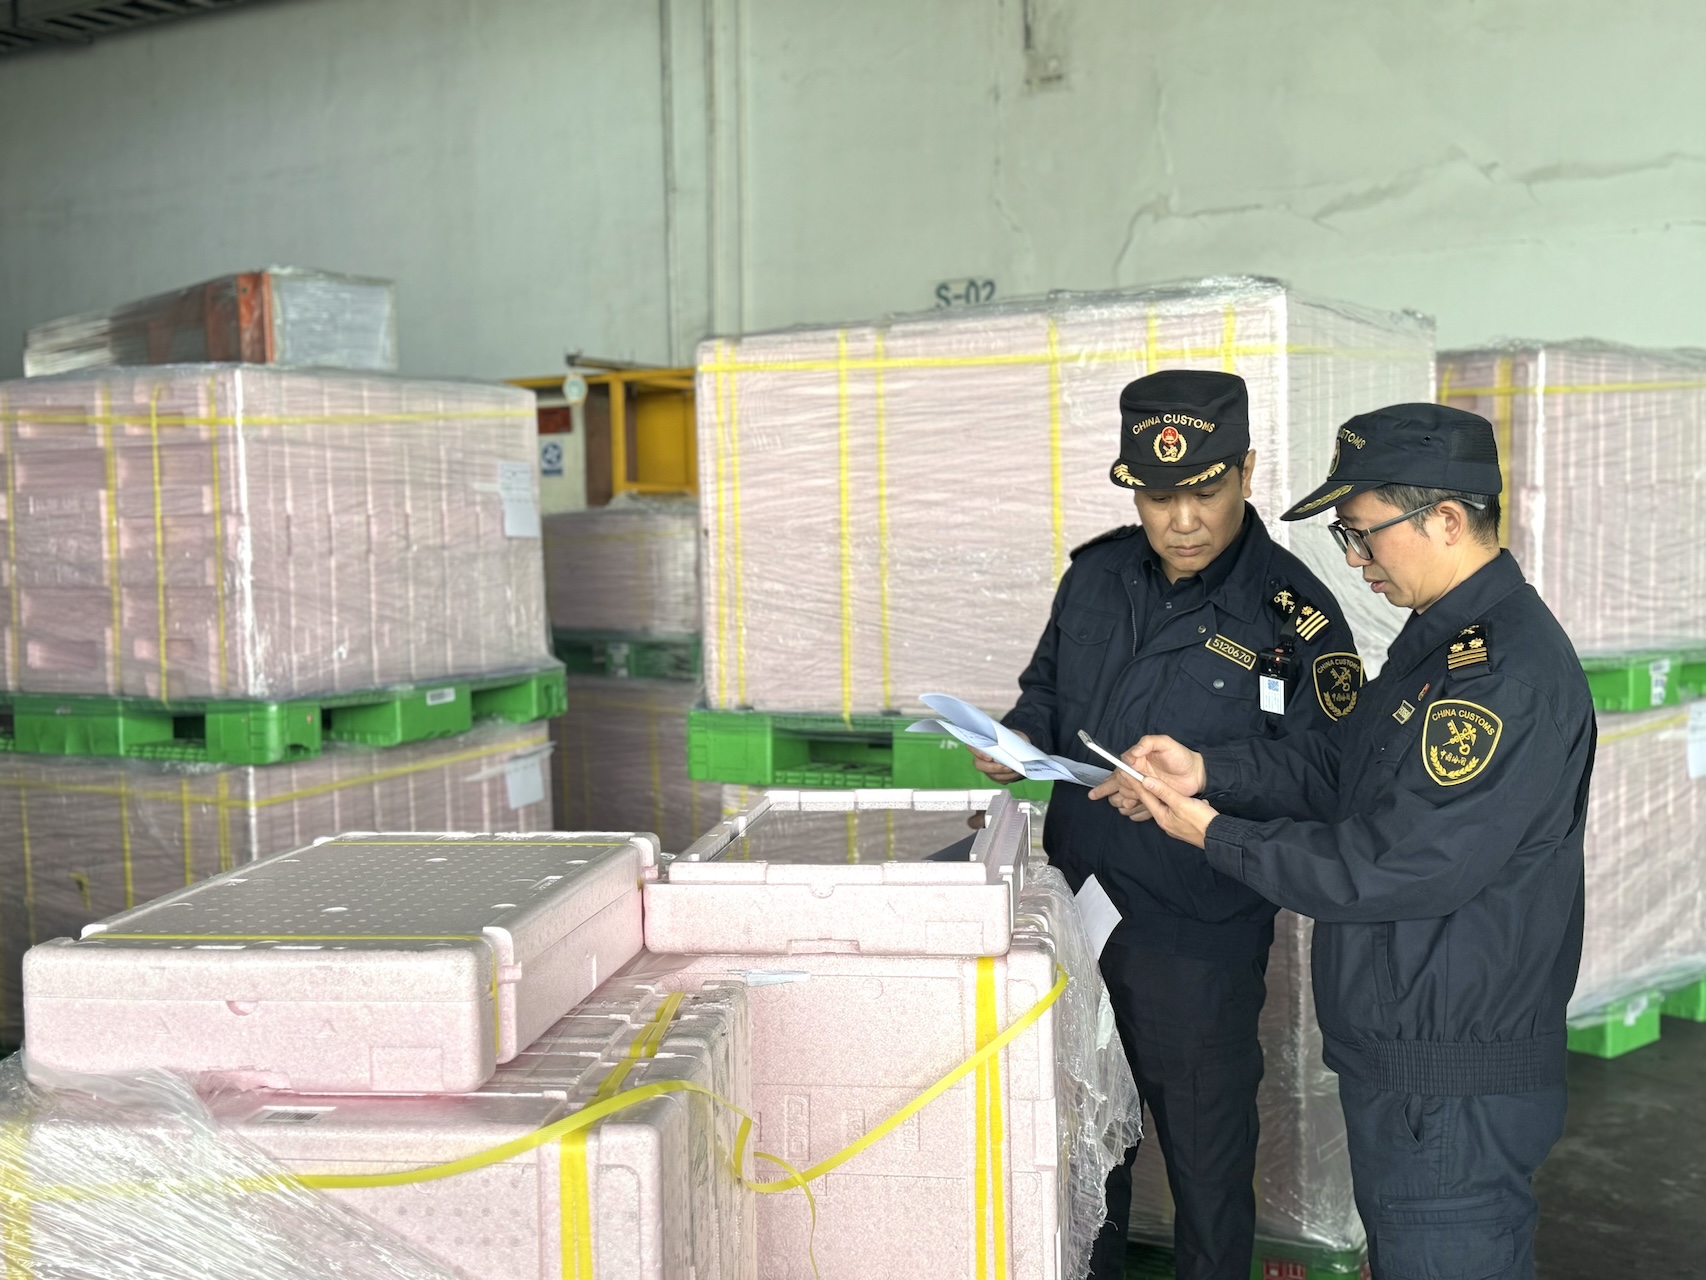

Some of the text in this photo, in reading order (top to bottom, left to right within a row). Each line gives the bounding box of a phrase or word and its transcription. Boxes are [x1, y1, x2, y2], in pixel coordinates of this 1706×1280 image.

[935, 279, 996, 307] S-02
[1132, 413, 1216, 435] CHINA CUSTOMS
[1212, 636, 1252, 664] 5120670
[1317, 659, 1361, 674] CHINA CUSTOMS
[1431, 709, 1457, 722] CHINA
[1459, 710, 1496, 736] CUSTOMS
